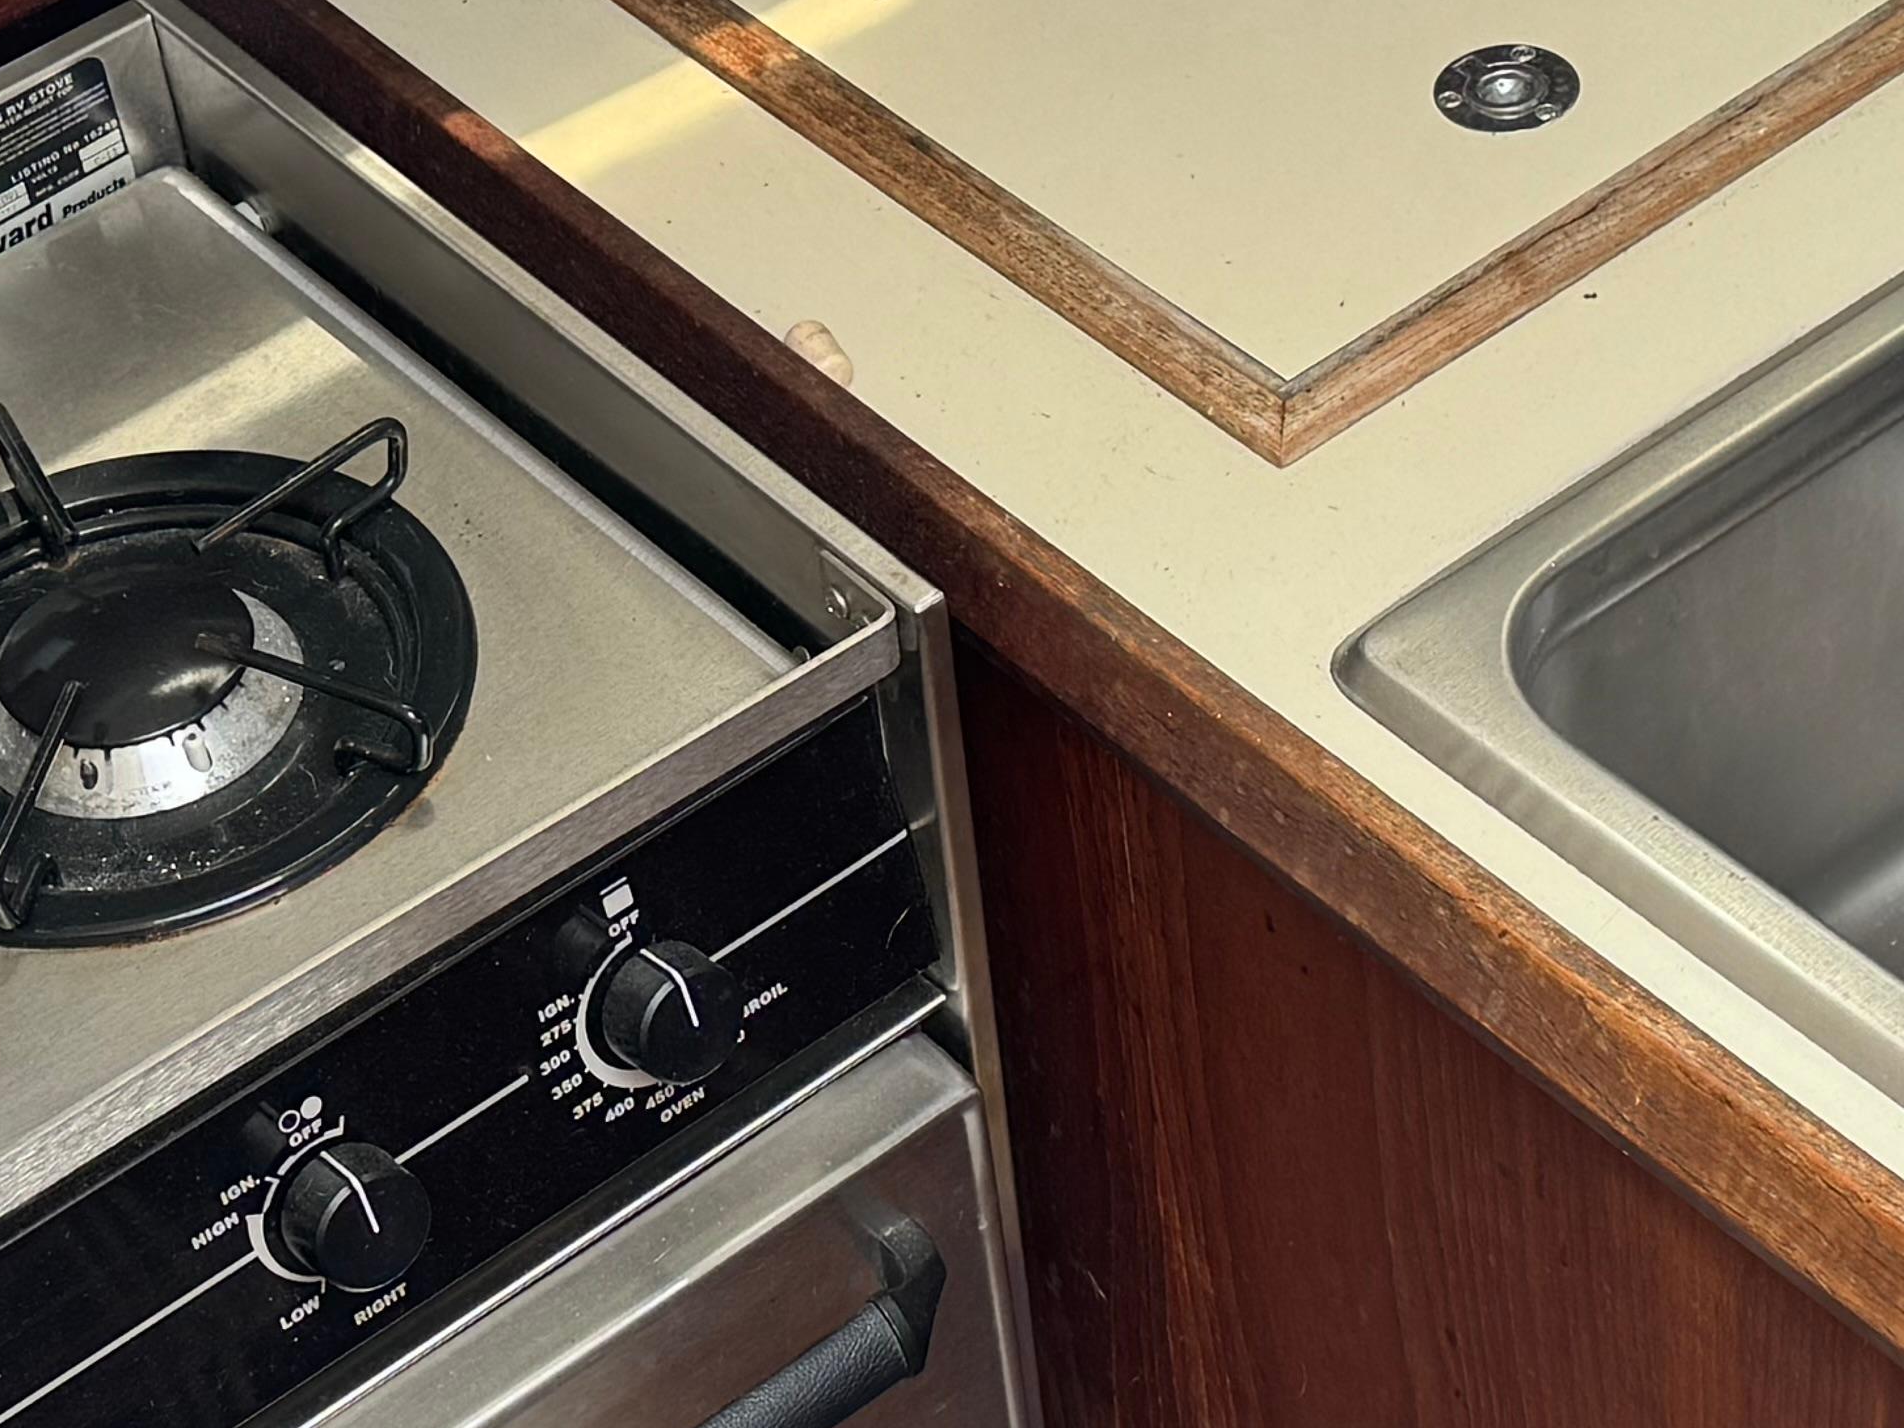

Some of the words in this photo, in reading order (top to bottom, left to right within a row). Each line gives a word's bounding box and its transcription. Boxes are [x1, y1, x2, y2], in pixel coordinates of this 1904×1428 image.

[6, 100, 25, 116] RV
[28, 72, 74, 103] STOVE
[62, 176, 126, 217] Products
[607, 910, 641, 939] OFF
[537, 995, 576, 1023] IGN.
[743, 981, 789, 1018] ROIL
[540, 1019, 573, 1048] 275
[539, 1048, 572, 1077] 300
[551, 1073, 584, 1101] 350
[644, 1084, 677, 1111] 450
[572, 1093, 605, 1121] 375
[604, 1096, 636, 1124] 400
[659, 1086, 707, 1123] OVEN
[288, 1120, 323, 1148] OFF
[218, 1175, 261, 1206] IGN.
[190, 1213, 240, 1251] HIGH
[278, 1295, 321, 1331] LOW
[353, 1282, 408, 1327] RIGHT
